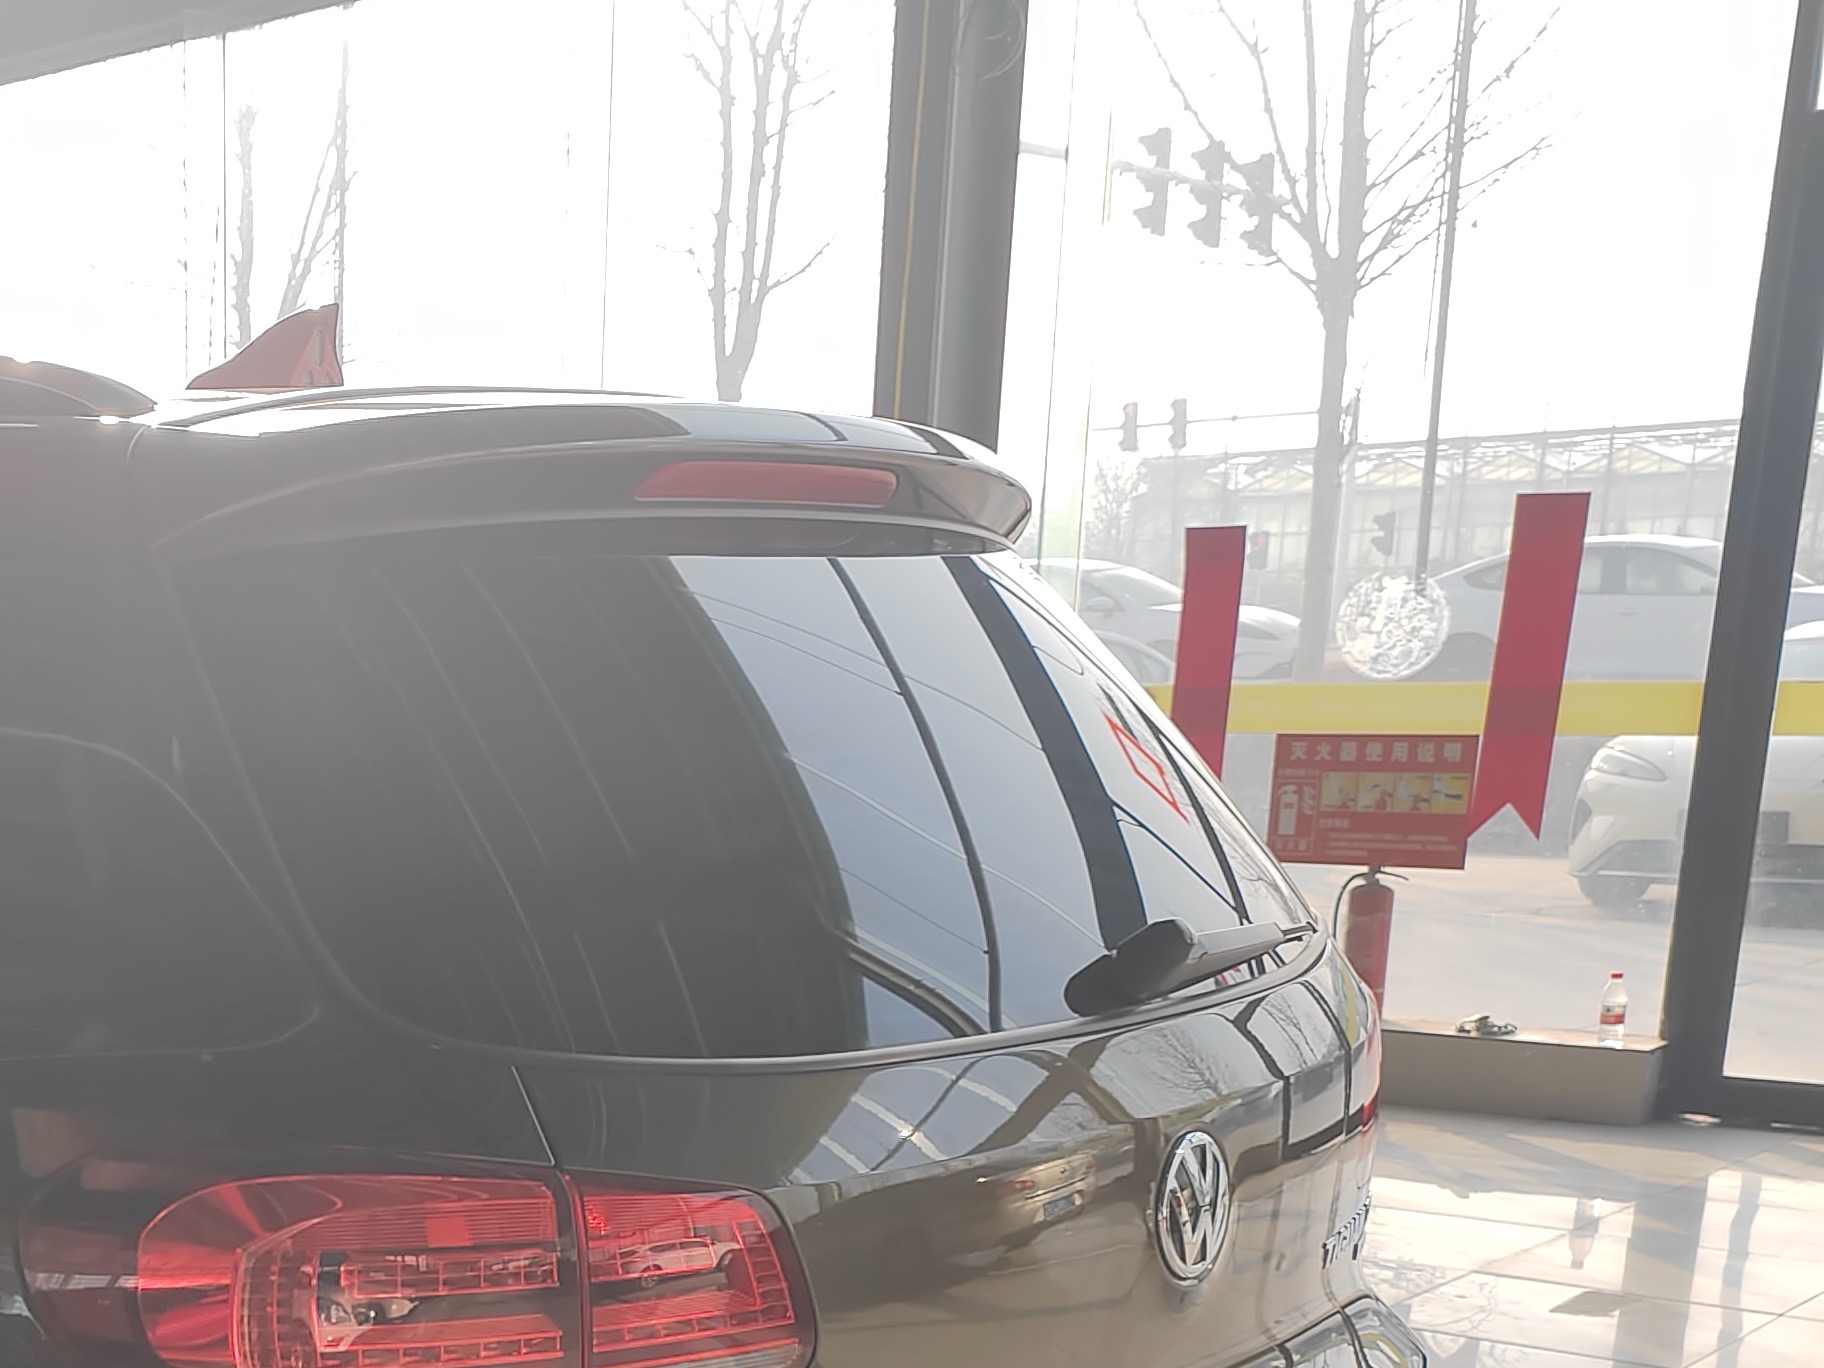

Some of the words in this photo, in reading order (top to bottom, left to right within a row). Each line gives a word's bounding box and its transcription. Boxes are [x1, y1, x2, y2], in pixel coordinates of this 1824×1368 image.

[1289, 741, 1463, 763] 灭火器使用说明
